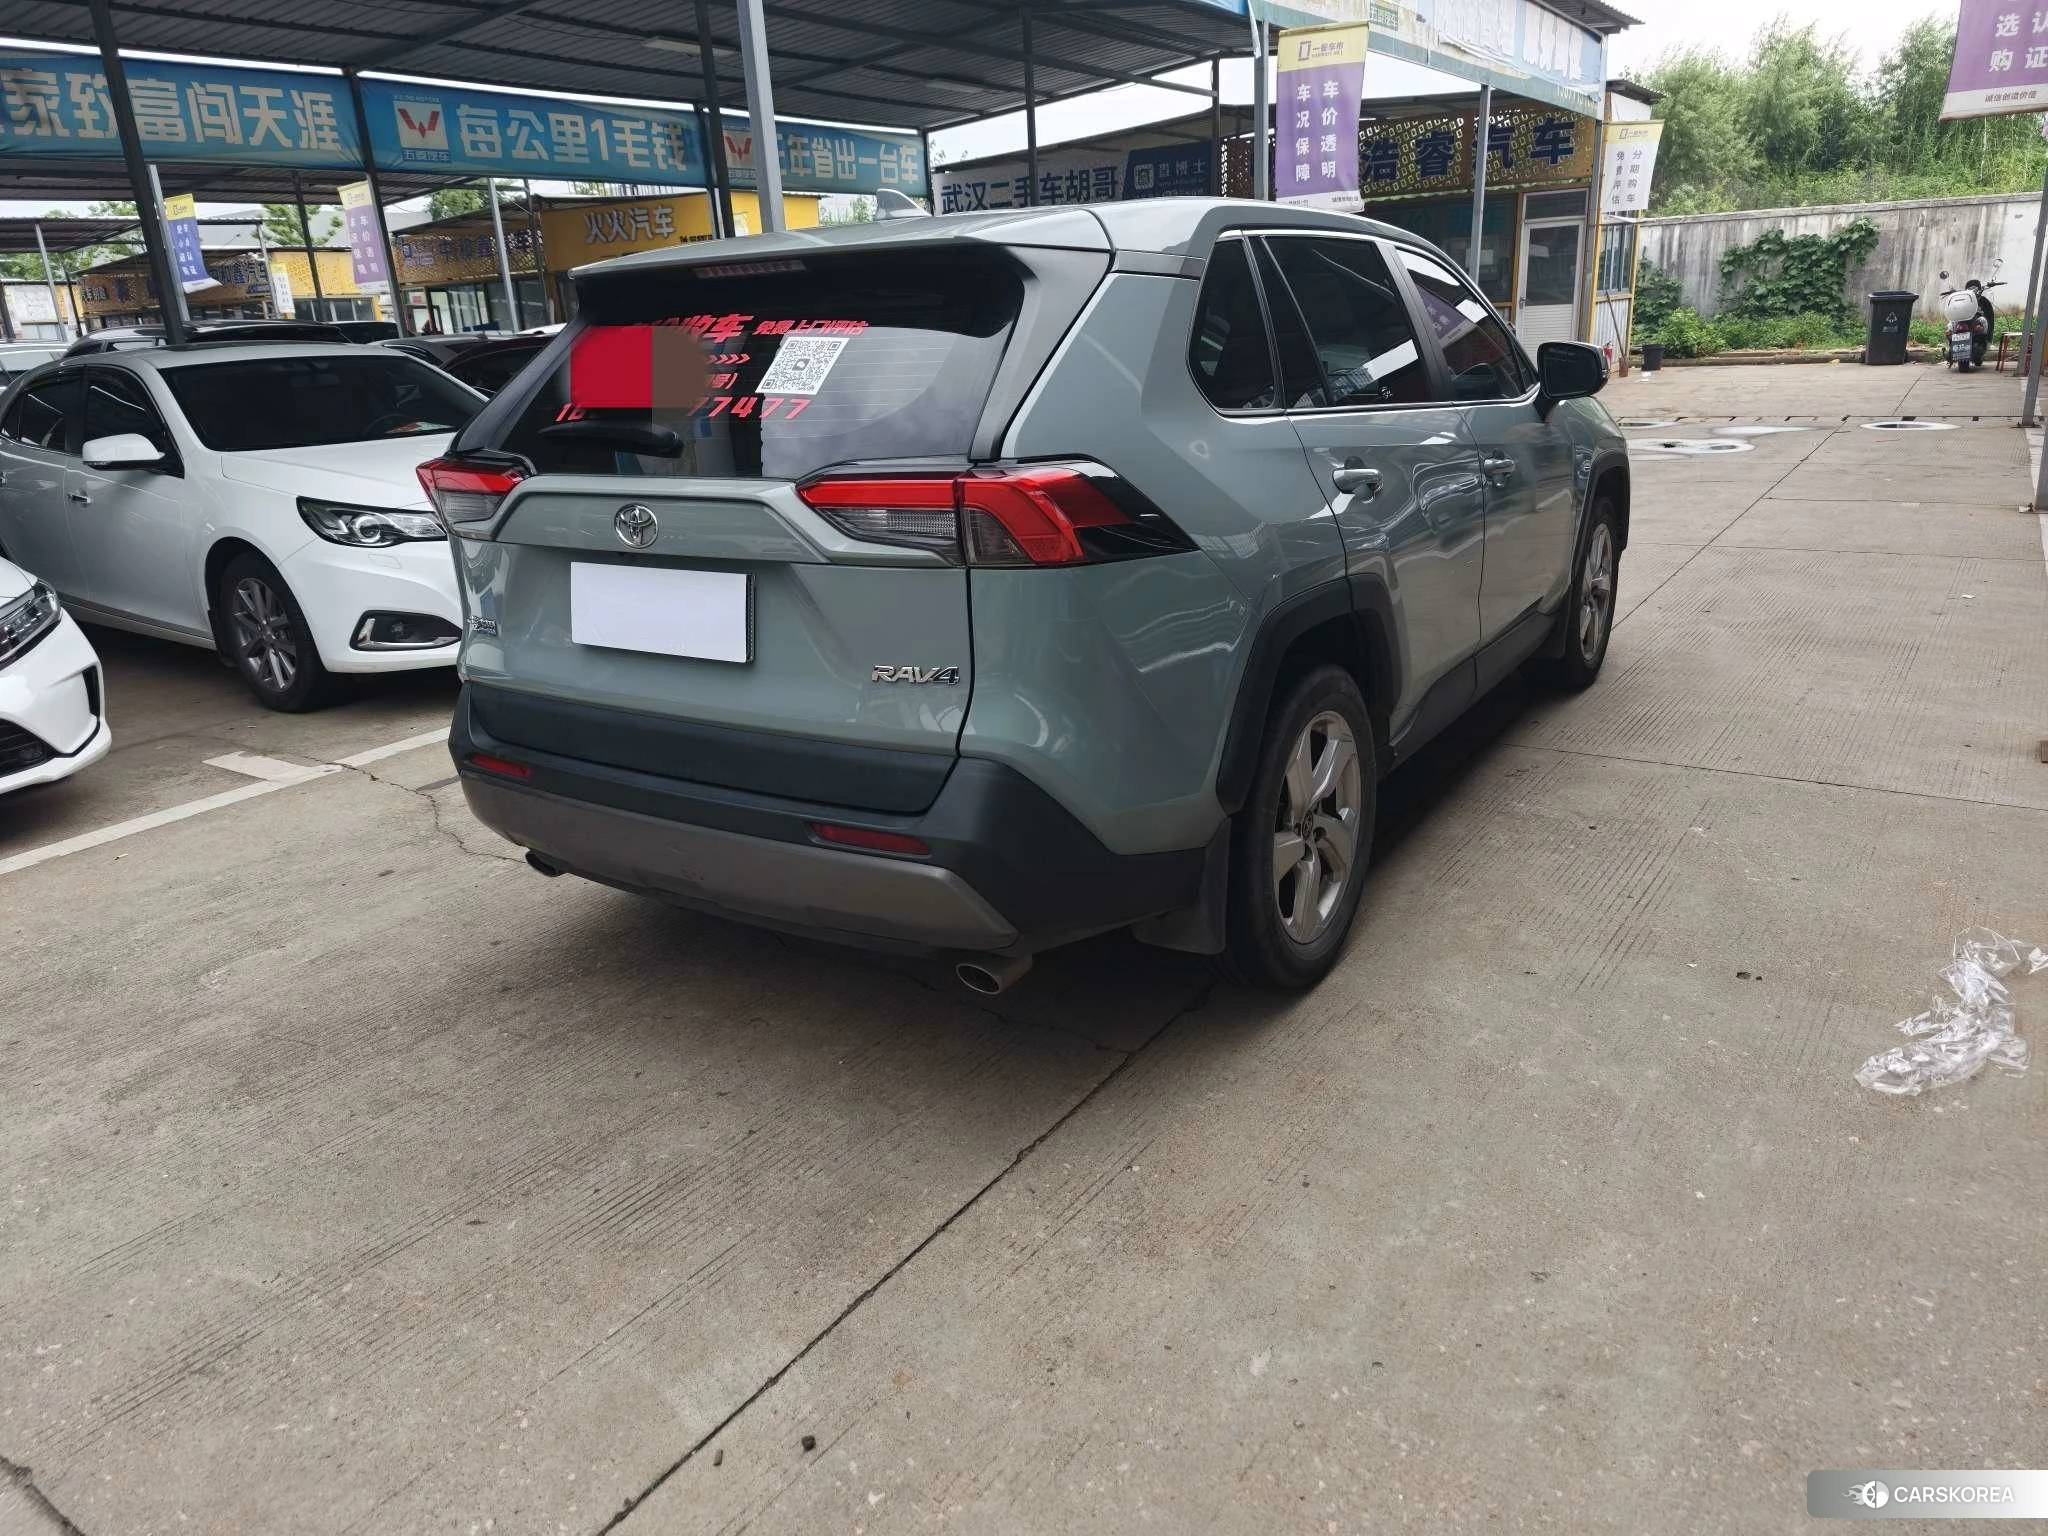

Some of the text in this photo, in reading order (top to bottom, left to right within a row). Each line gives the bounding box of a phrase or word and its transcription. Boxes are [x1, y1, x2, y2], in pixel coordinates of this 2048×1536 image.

[0, 67, 343, 151] 家致富闯天涯
[456, 104, 688, 171] 每公里1毛钱
[1294, 83, 1312, 182] 车况保障
[1320, 79, 1340, 179] 车价透明
[941, 166, 1119, 215] 武汉二手车胡哥
[871, 665, 960, 685] RAV4
